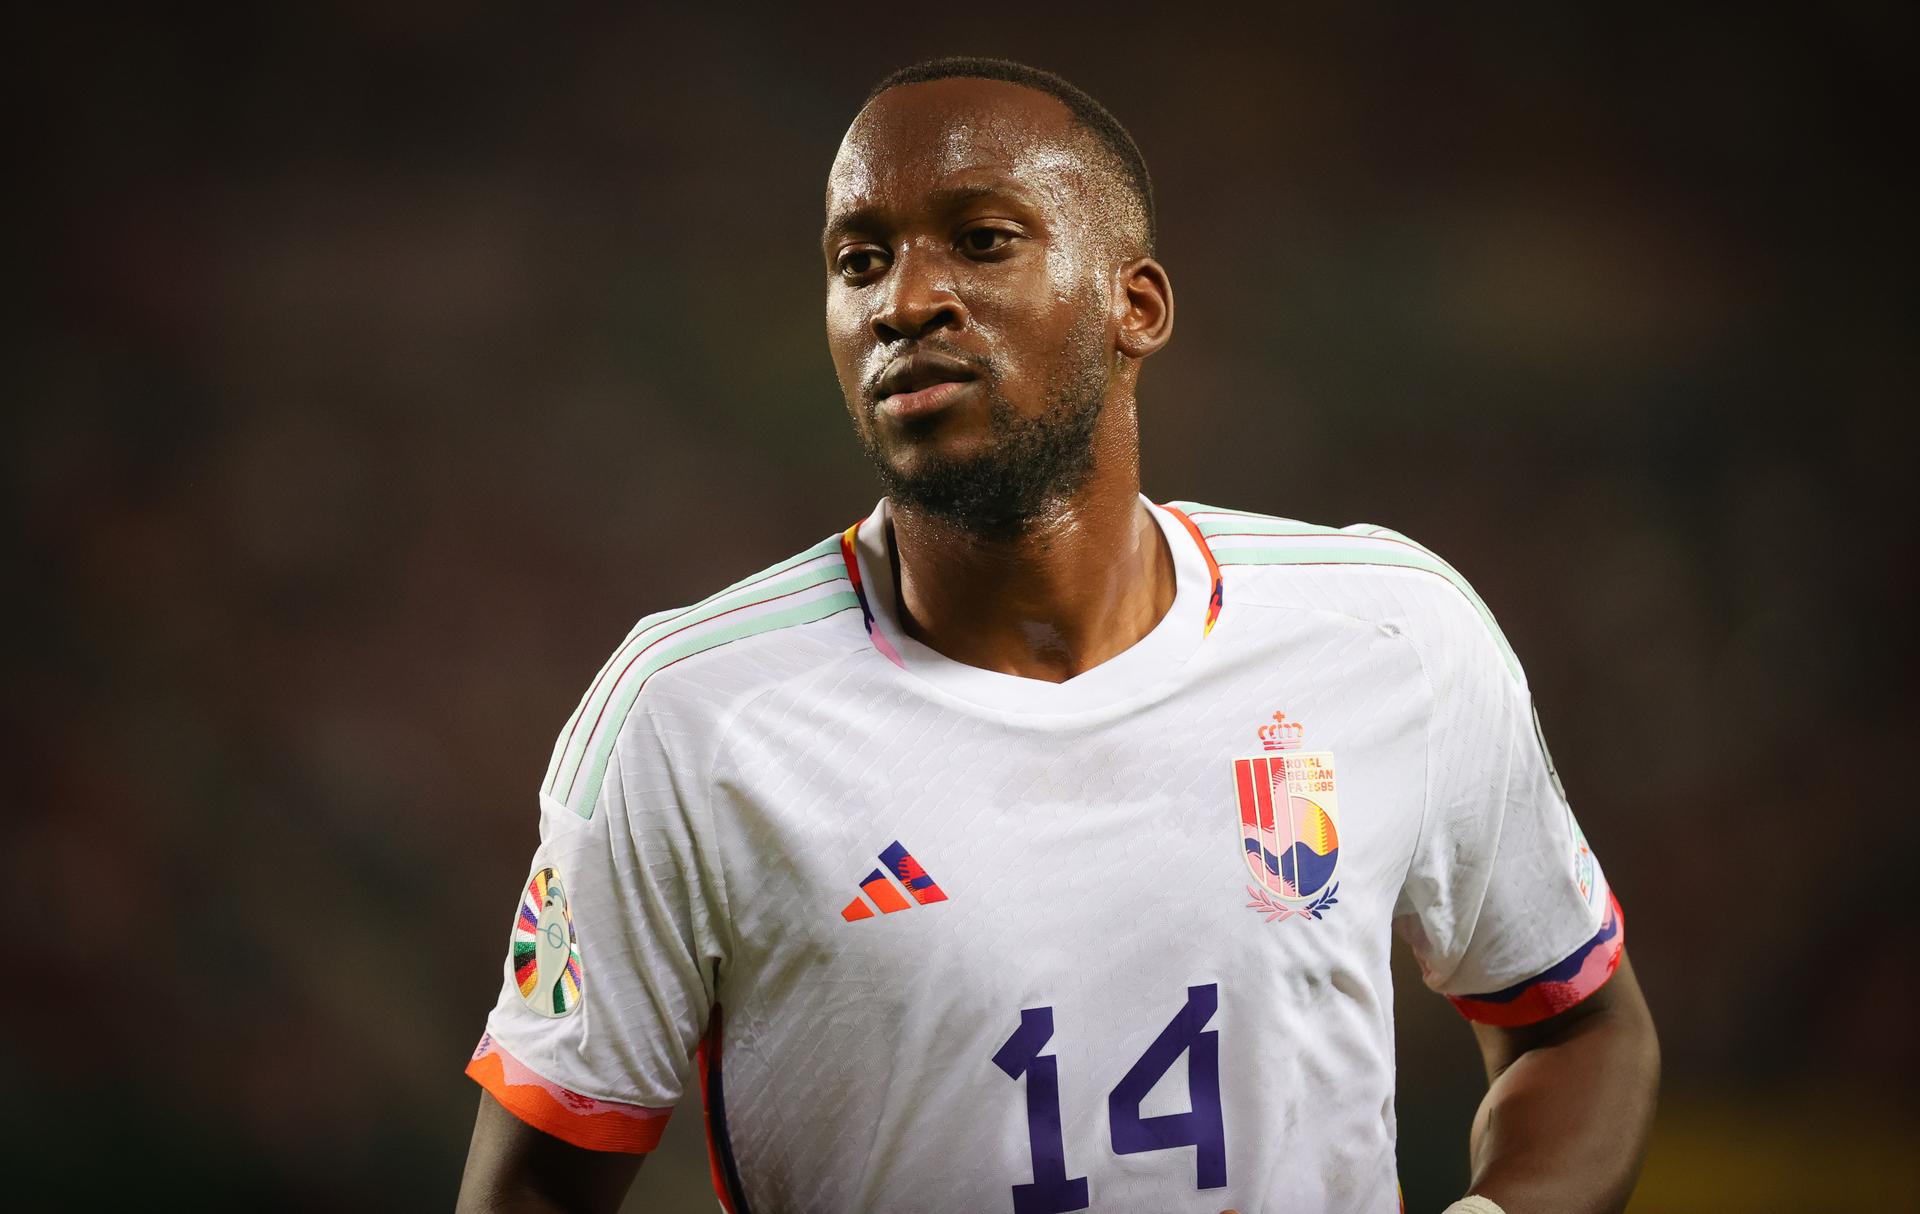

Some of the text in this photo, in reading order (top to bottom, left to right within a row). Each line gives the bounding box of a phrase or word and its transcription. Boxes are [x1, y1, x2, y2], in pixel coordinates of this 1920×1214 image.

[1286, 757, 1322, 768] ROYAL
[1287, 769, 1333, 780] BELGIAN
[991, 983, 1227, 1214] 14
